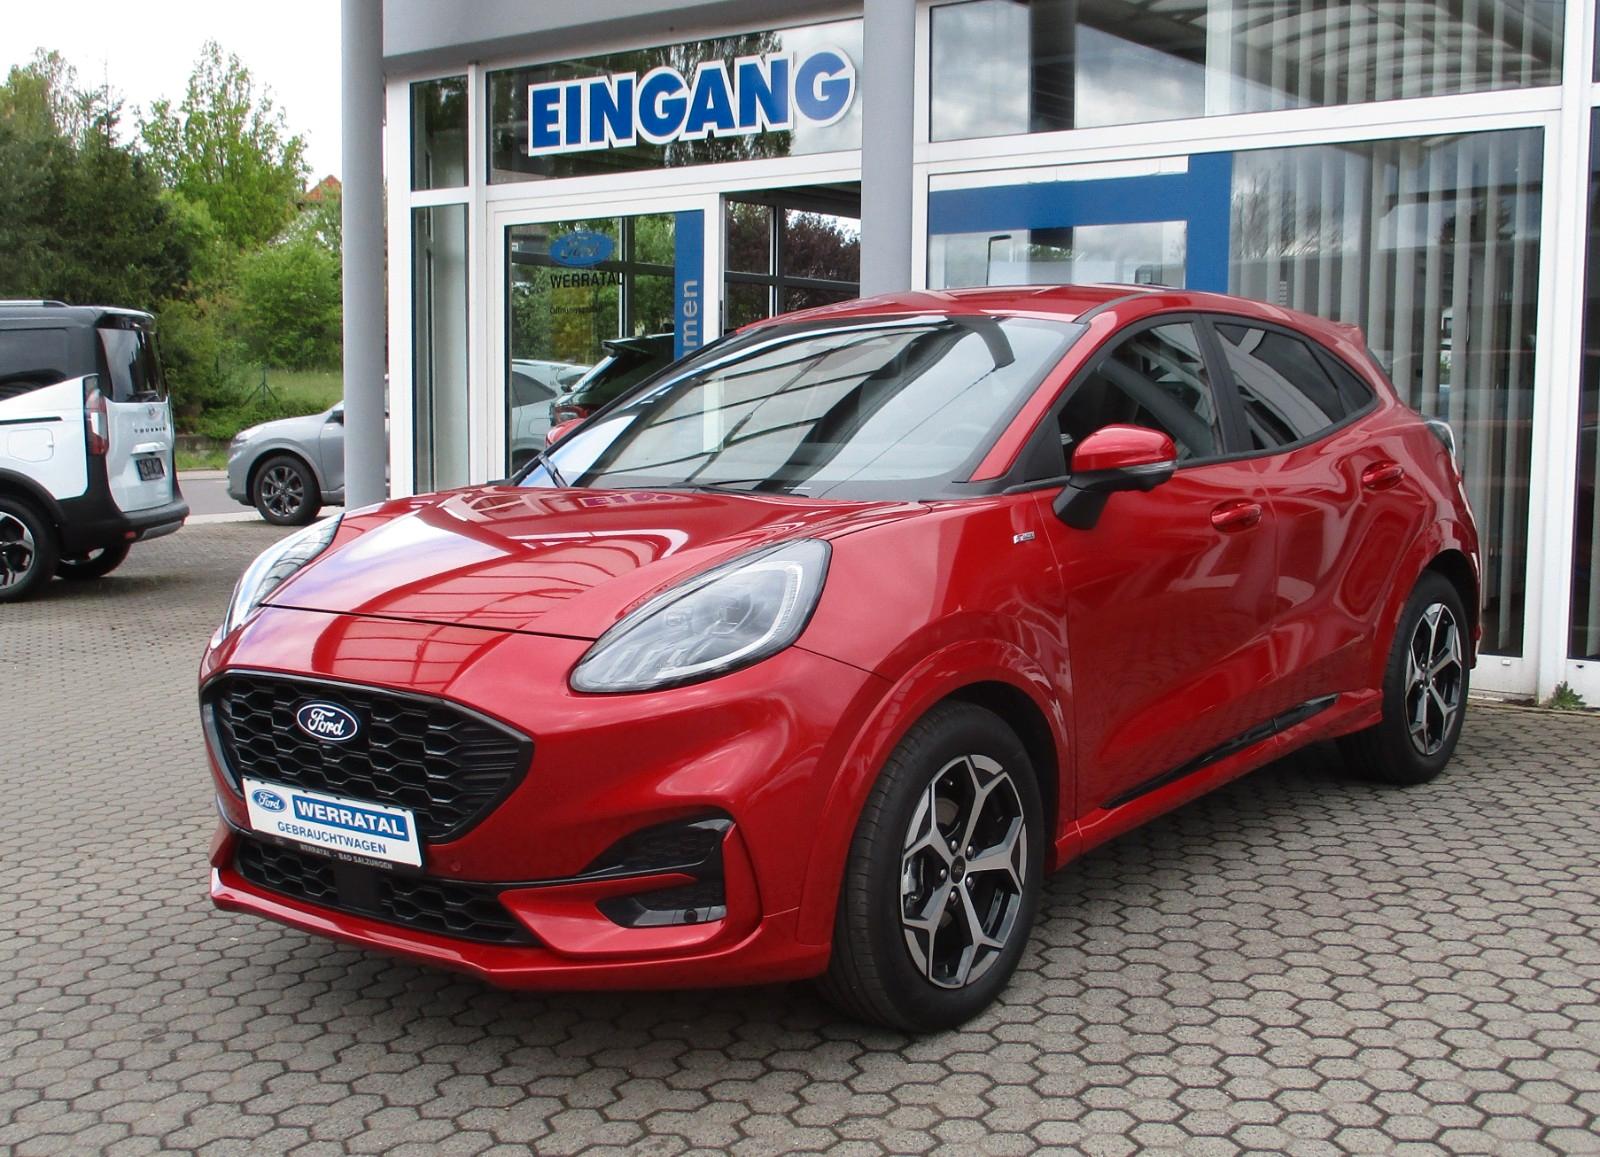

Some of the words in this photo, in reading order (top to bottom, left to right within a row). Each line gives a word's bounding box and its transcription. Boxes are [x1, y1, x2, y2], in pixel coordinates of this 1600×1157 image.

[529, 46, 855, 156] EINGANG
[550, 272, 623, 289] WERRATAL
[307, 707, 345, 737] Ford
[257, 792, 281, 811] Ford
[295, 799, 405, 837] WERRATAL
[277, 821, 387, 854] GEBRAUCHTWAGEN
[338, 852, 353, 863] BAD
